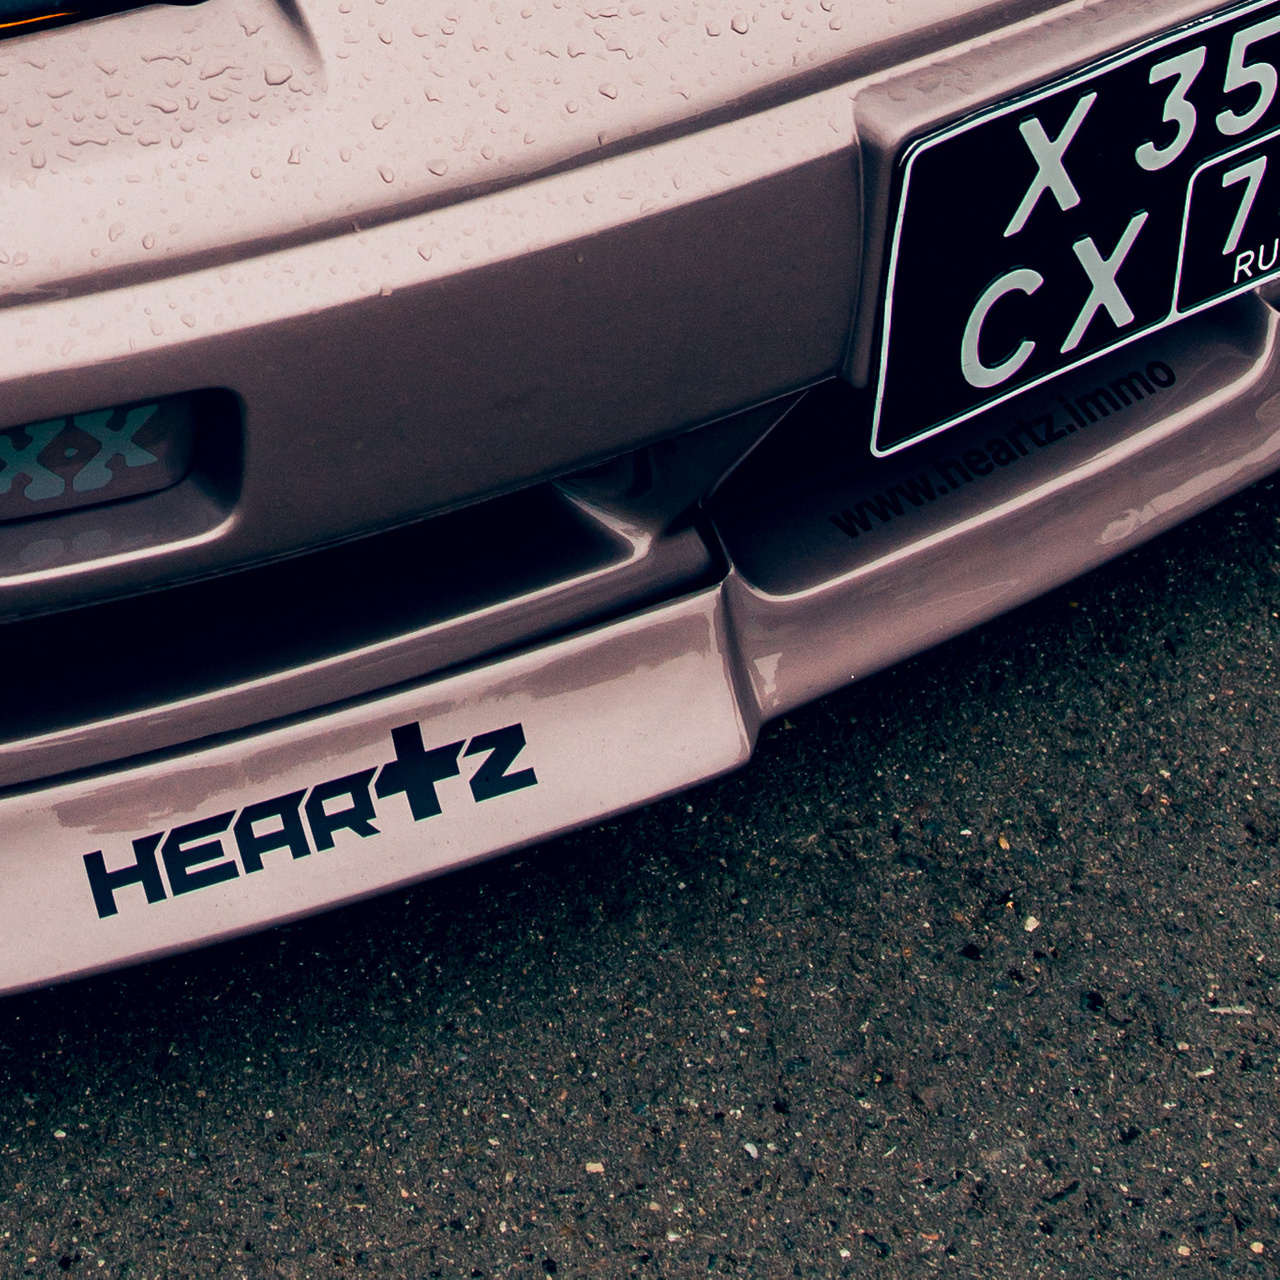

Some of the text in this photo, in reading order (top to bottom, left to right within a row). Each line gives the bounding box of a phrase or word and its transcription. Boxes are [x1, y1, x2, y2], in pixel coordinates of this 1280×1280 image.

[1004, 92, 1097, 237] X
[961, 212, 1148, 388] CX
[828, 360, 1176, 539] www.heartz.immo
